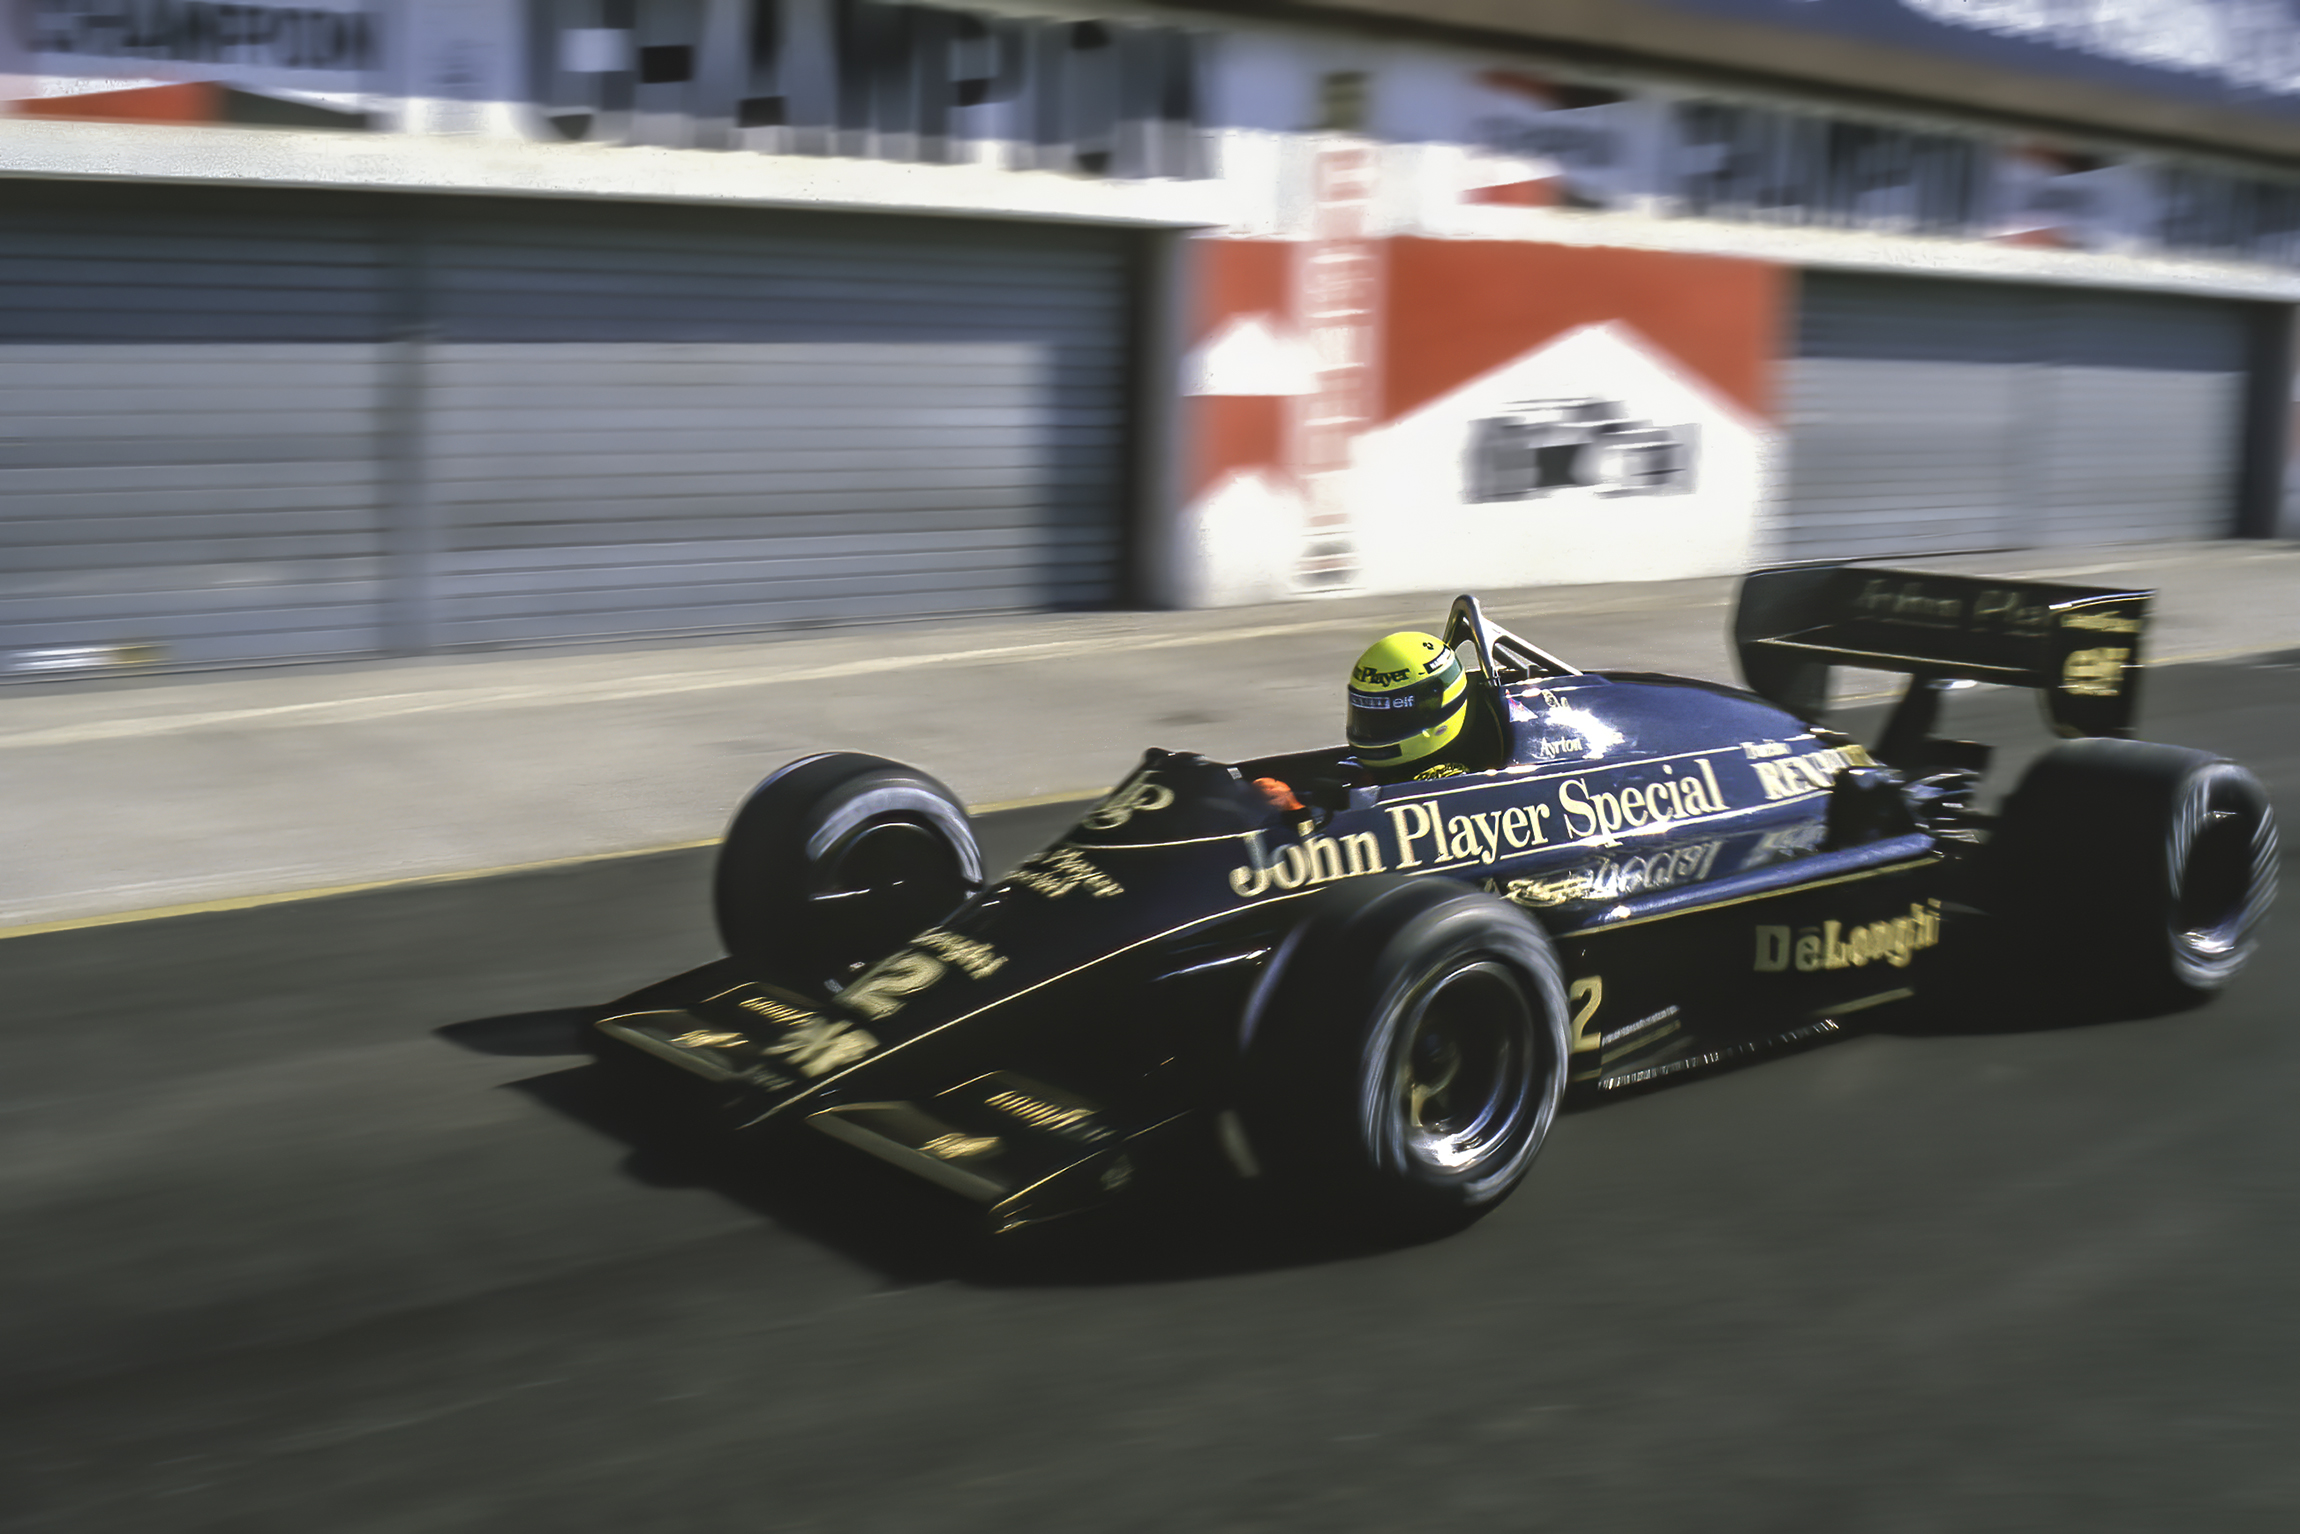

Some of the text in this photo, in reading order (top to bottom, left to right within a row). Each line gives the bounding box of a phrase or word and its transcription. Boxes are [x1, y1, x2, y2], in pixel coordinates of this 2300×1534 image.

[1361, 666, 1410, 688] Player
[1392, 695, 1414, 708] elf
[1540, 736, 1583, 759] Ayrton
[1229, 820, 1387, 897] John
[1385, 801, 1549, 865] Player
[1559, 758, 1731, 848] Special
